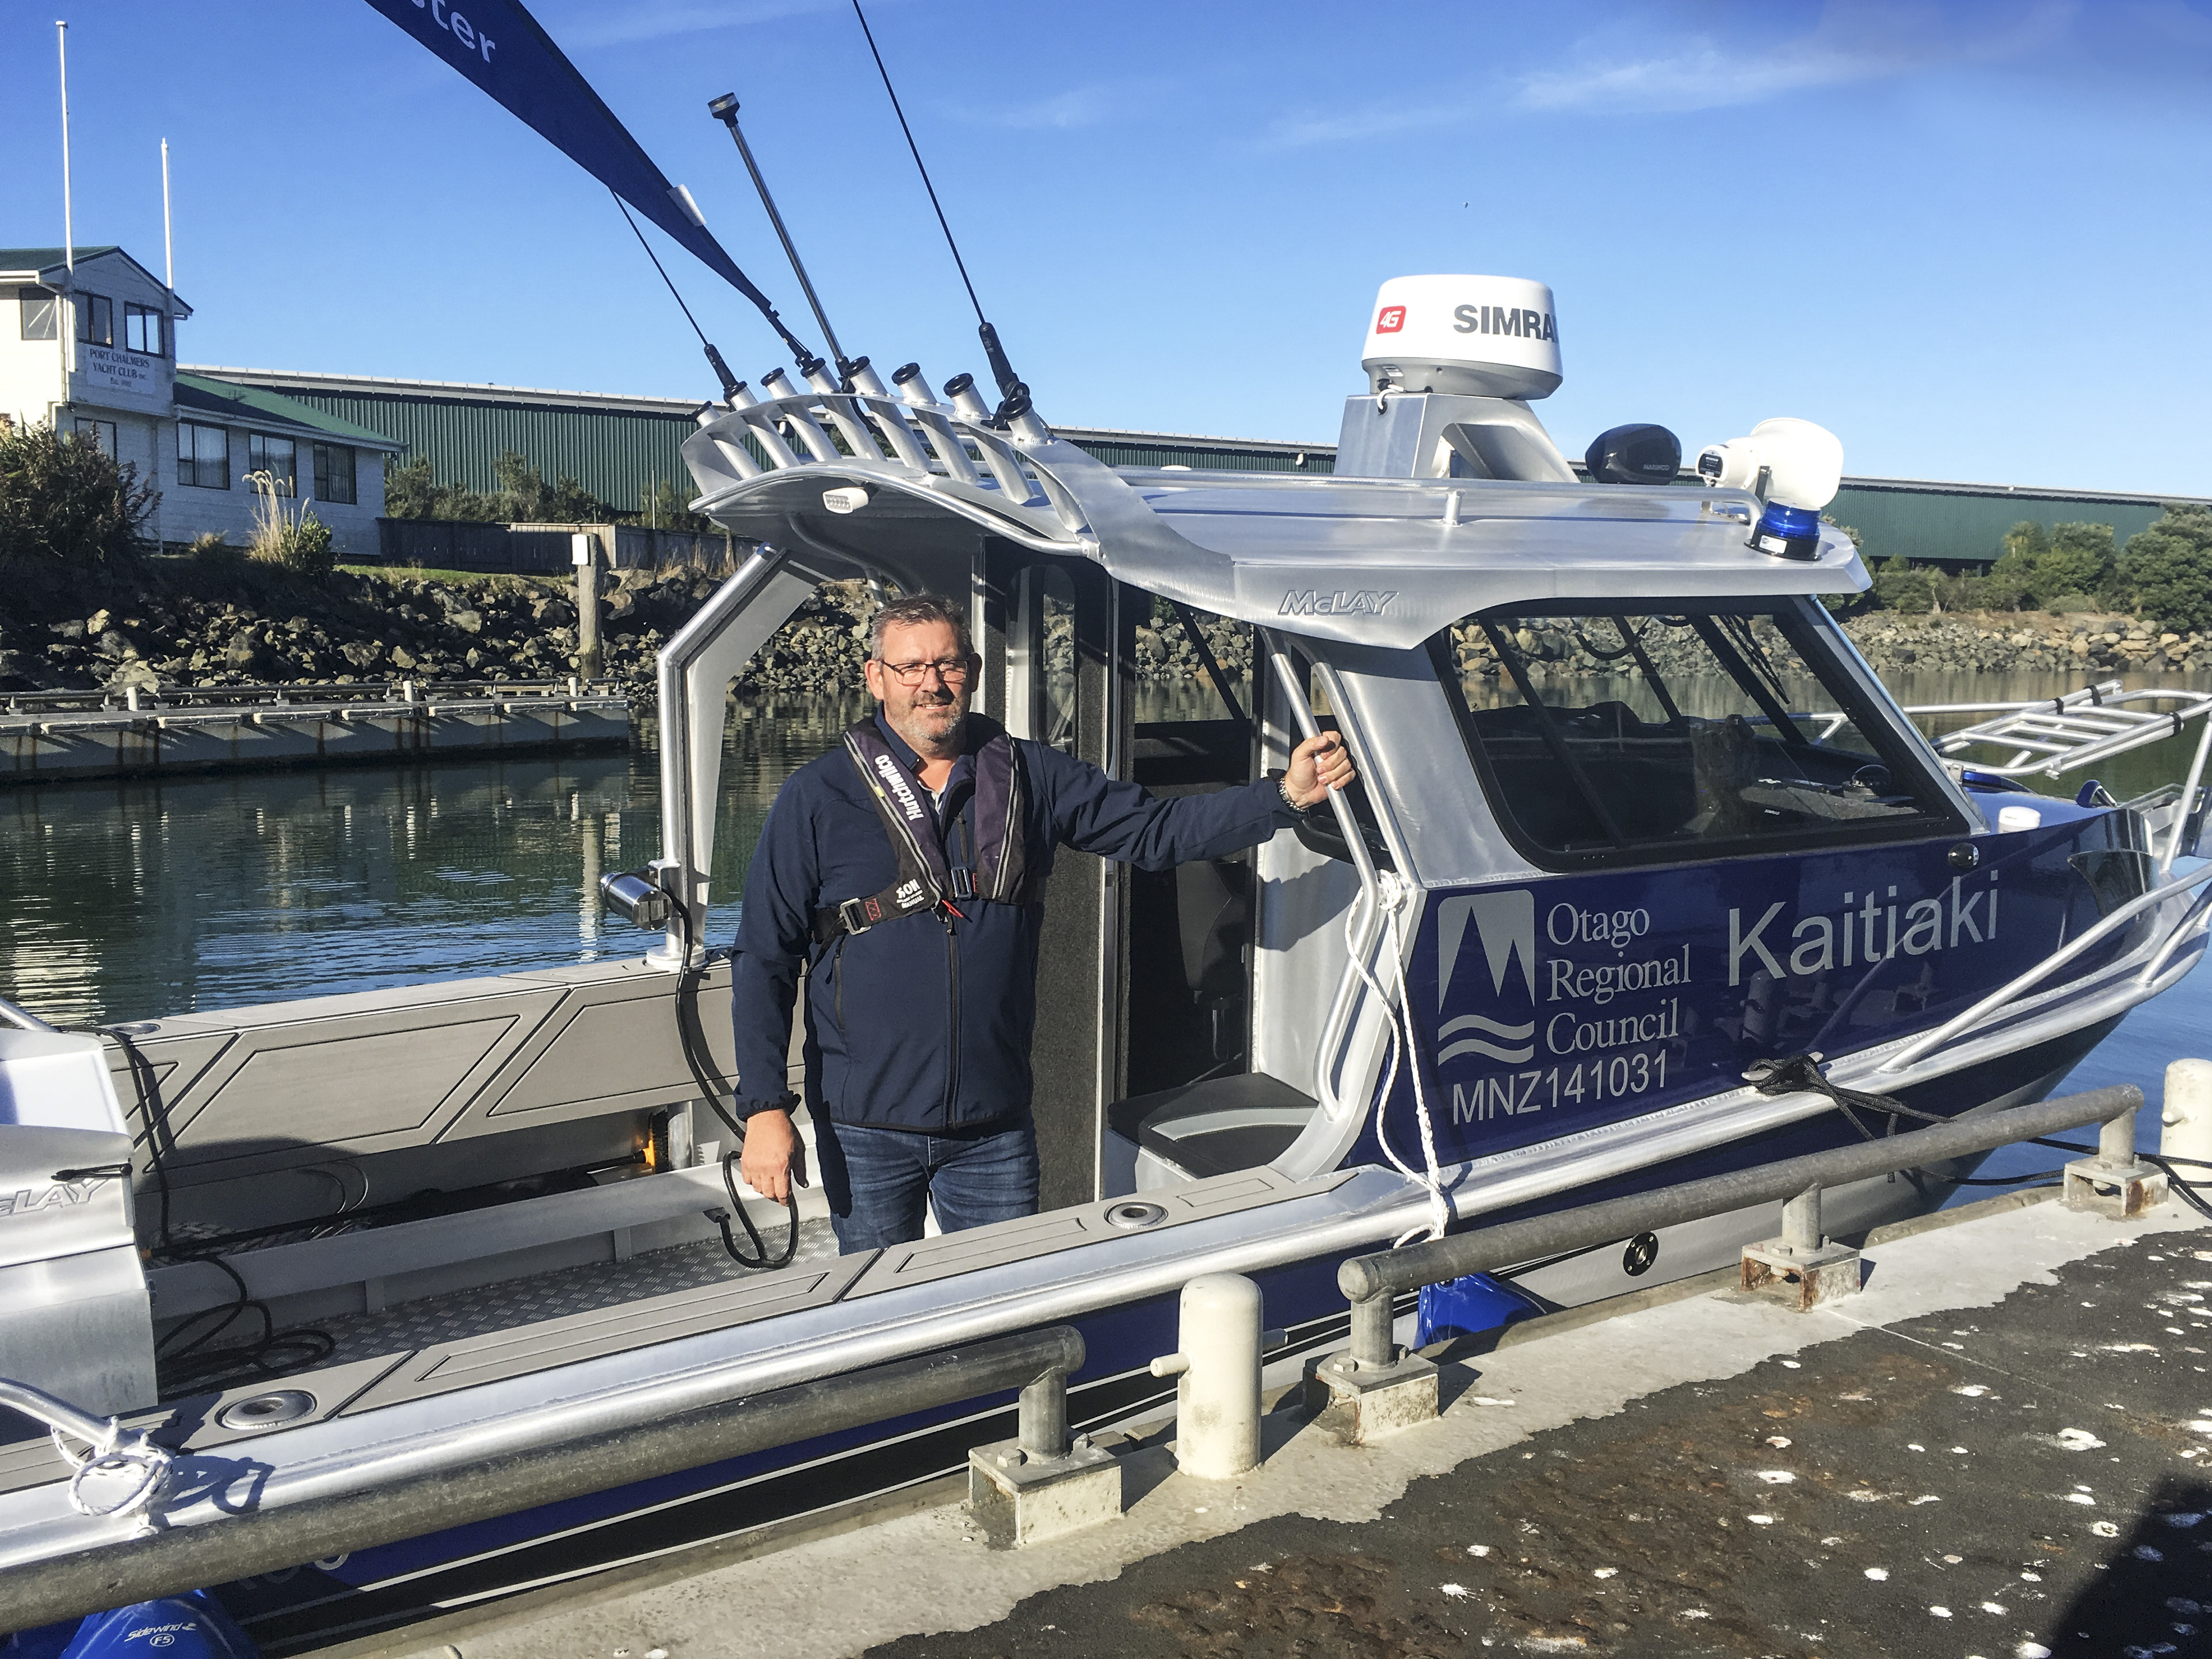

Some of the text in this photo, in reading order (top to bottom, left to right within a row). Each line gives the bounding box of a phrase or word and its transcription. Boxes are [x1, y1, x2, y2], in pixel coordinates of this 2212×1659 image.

[411, 0, 495, 63] ter
[1379, 310, 1402, 328] 4G
[1453, 304, 1558, 344] SIMRA
[89, 348, 150, 368] PORT CHALMERS
[92, 361, 116, 375] YACHT
[117, 367, 138, 379] CLUB
[875, 754, 924, 821] Hutchwilco
[1547, 903, 1650, 948] Otago
[1729, 869, 1988, 975] Kaitiaki
[1546, 943, 1692, 1005] Regional
[1546, 997, 1679, 1055] Council
[1454, 1049, 1667, 1126] MNZ141031
